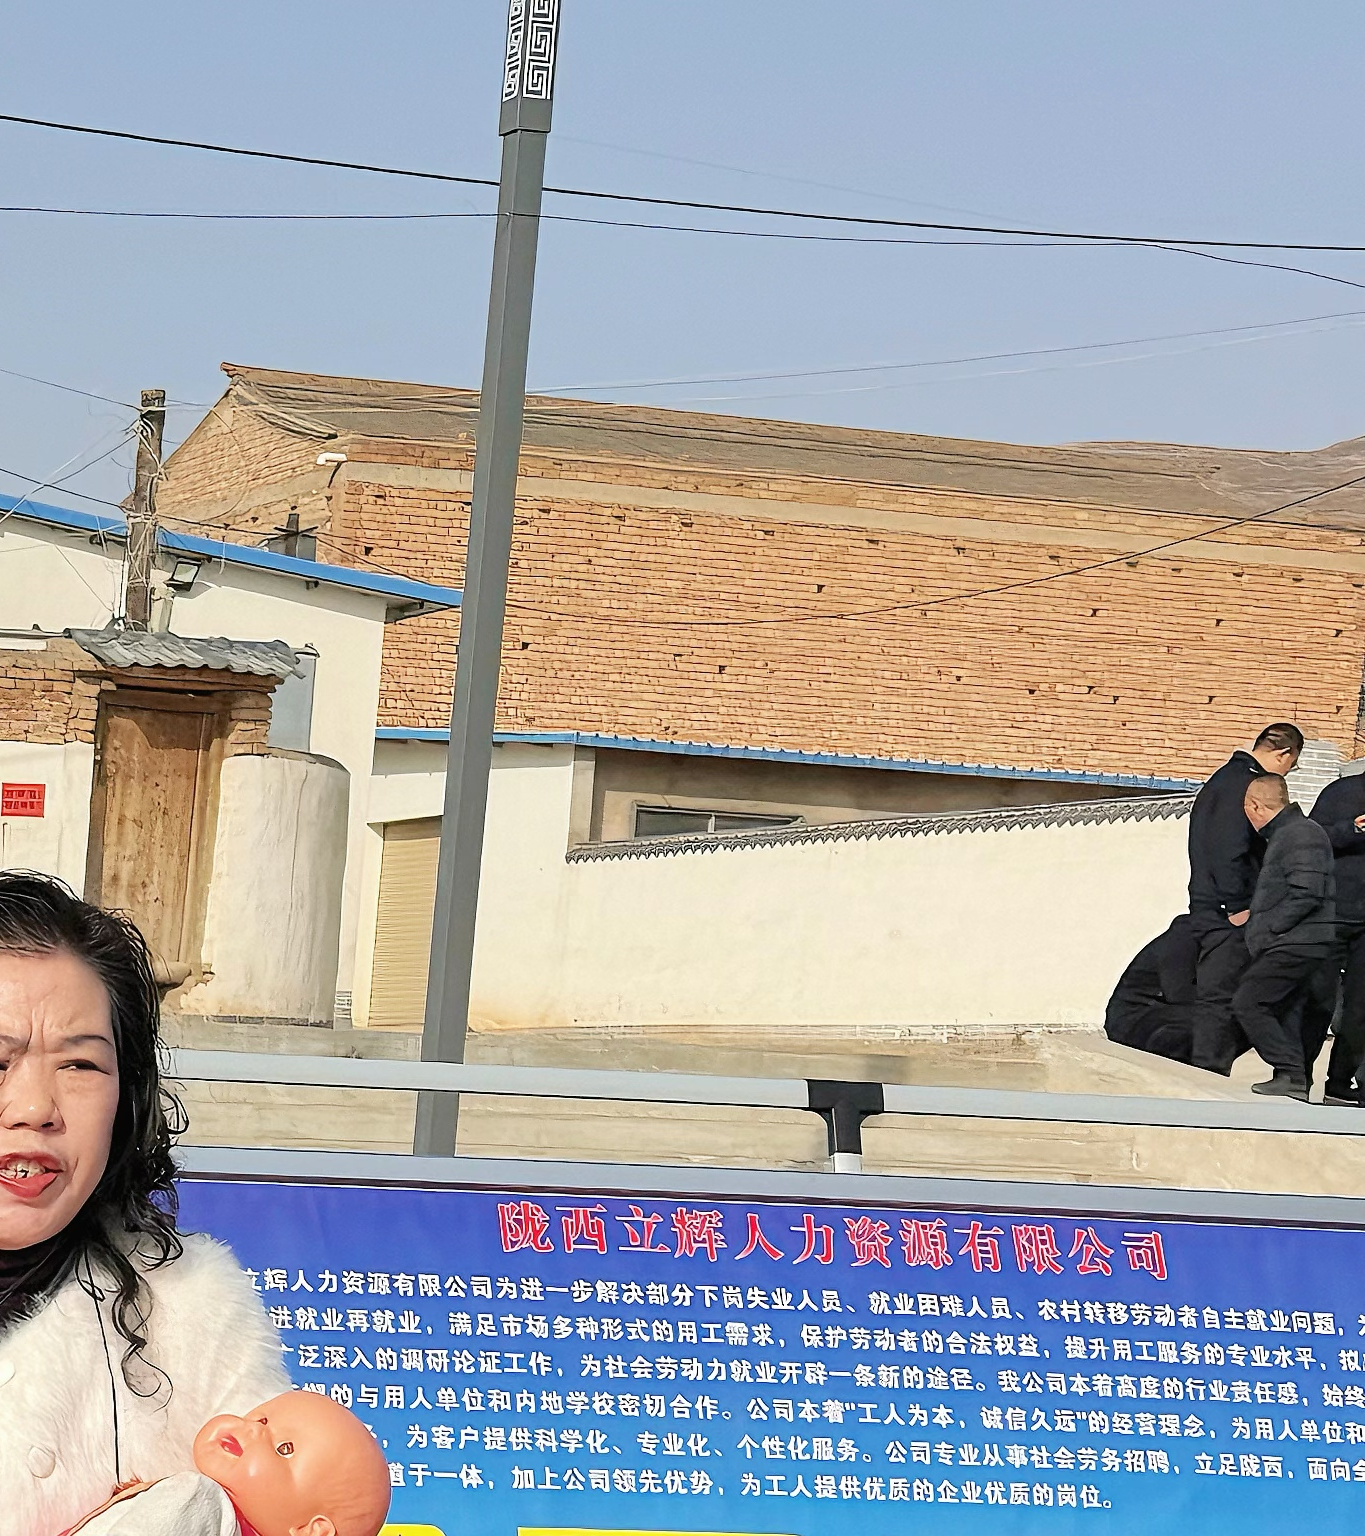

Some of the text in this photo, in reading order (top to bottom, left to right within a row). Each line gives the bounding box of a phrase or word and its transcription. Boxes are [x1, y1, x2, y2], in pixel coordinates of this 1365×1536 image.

[497, 1200, 1169, 1281] 陇西立辉人力资源有限公司
